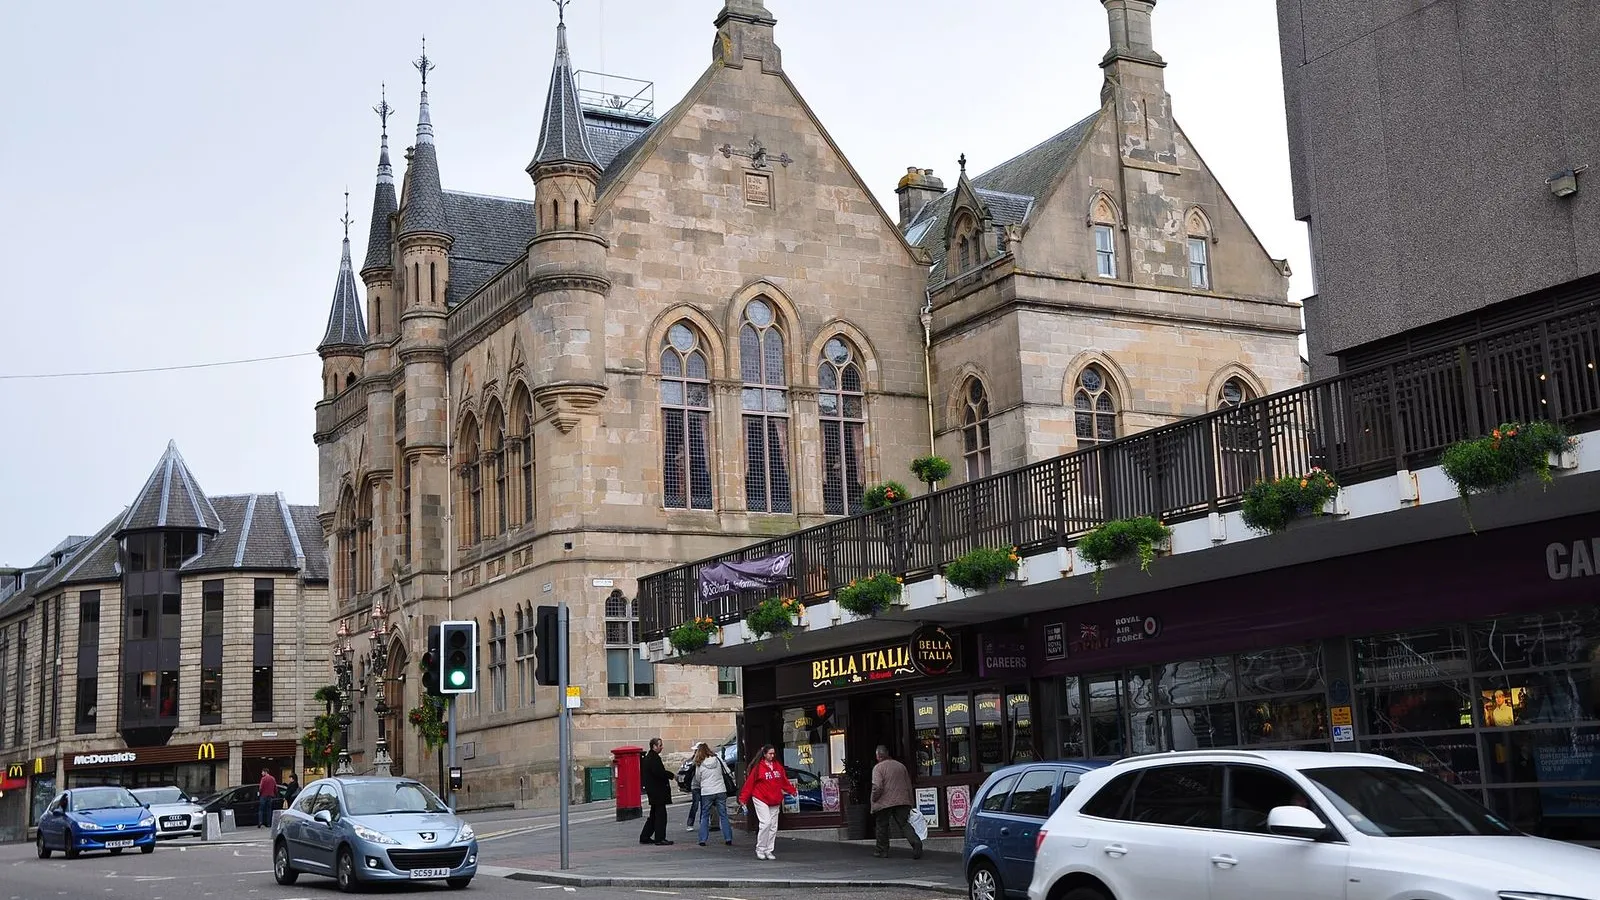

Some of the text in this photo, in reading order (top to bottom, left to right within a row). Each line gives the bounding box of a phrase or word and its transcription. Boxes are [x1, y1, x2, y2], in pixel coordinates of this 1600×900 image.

[1115, 615, 1141, 626] ROYAL
[1116, 626, 1130, 634] AIR
[1117, 633, 1144, 643] FORCE
[919, 640, 951, 650] BELLA
[918, 651, 953, 660] ITALIA
[986, 656, 1027, 669] CAREERS
[1387, 653, 1434, 669] INFANTRY
[812, 655, 857, 680] BELLA
[1388, 672, 1400, 681] NO
[944, 703, 969, 716] SPAGHETTI
[979, 701, 995, 710] PANINI
[73, 752, 136, 765] McDonald's
[414, 867, 447, 877] SC59 AAJ
